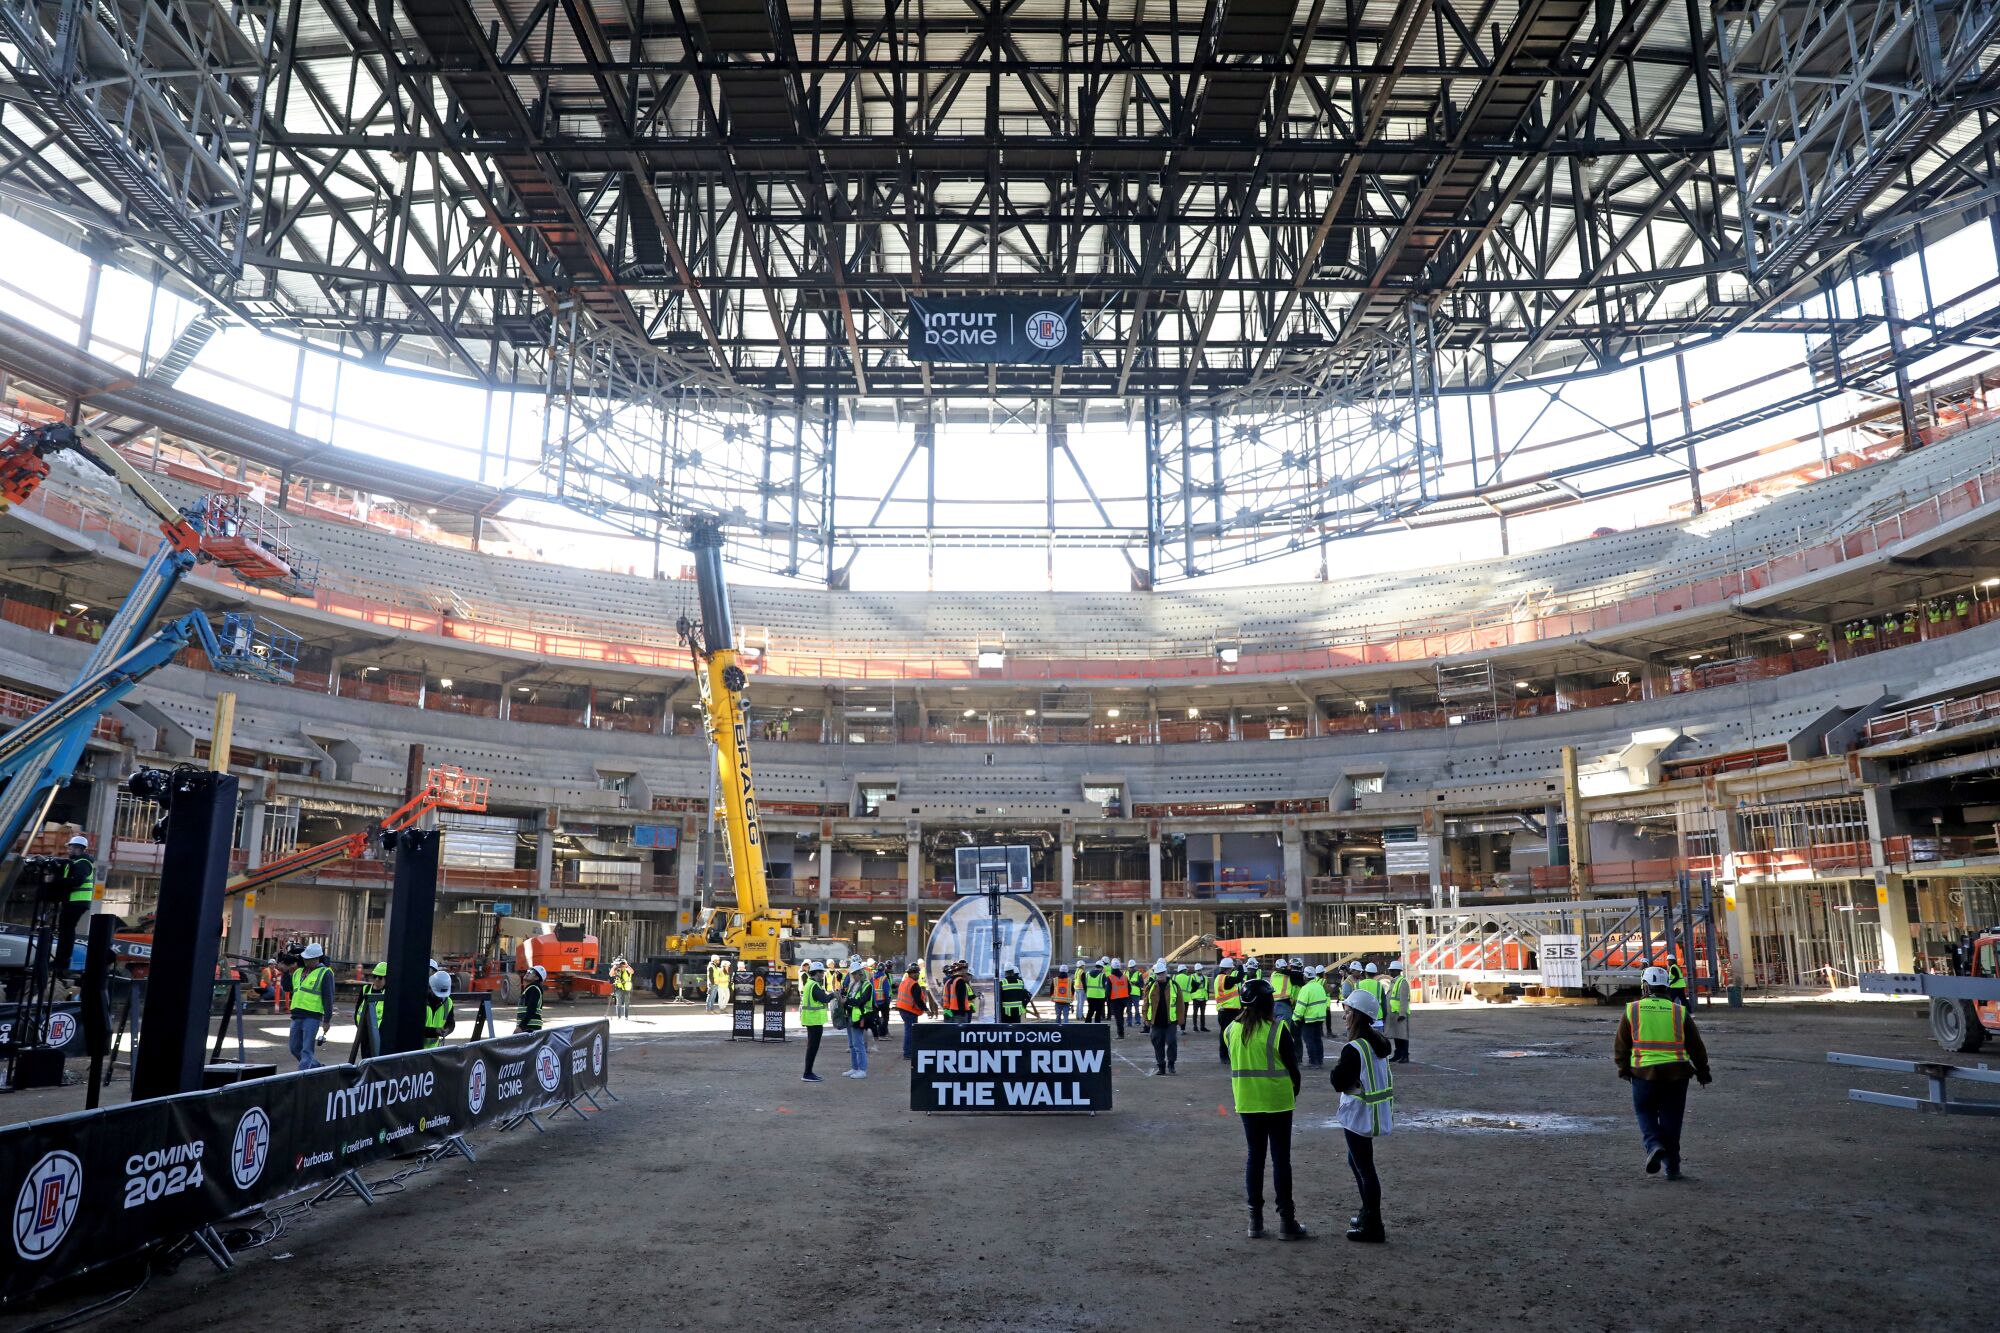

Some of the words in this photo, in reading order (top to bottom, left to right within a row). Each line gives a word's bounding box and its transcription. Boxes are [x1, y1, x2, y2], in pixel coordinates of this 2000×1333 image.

[735, 724, 759, 845] BRAGG
[1590, 935, 1616, 943] ULTA
[572, 1047, 588, 1060] COMING
[917, 1049, 1023, 1074] FRONT
[1031, 1049, 1105, 1074] ROW
[932, 1081, 995, 1106] THE
[1000, 1081, 1091, 1106] WALL
[303, 1150, 334, 1168] turbotax
[385, 1123, 415, 1143] quickbooks
[425, 1114, 451, 1129] mailchimp
[125, 1140, 205, 1176] COMING
[123, 1161, 204, 1210] 2024
